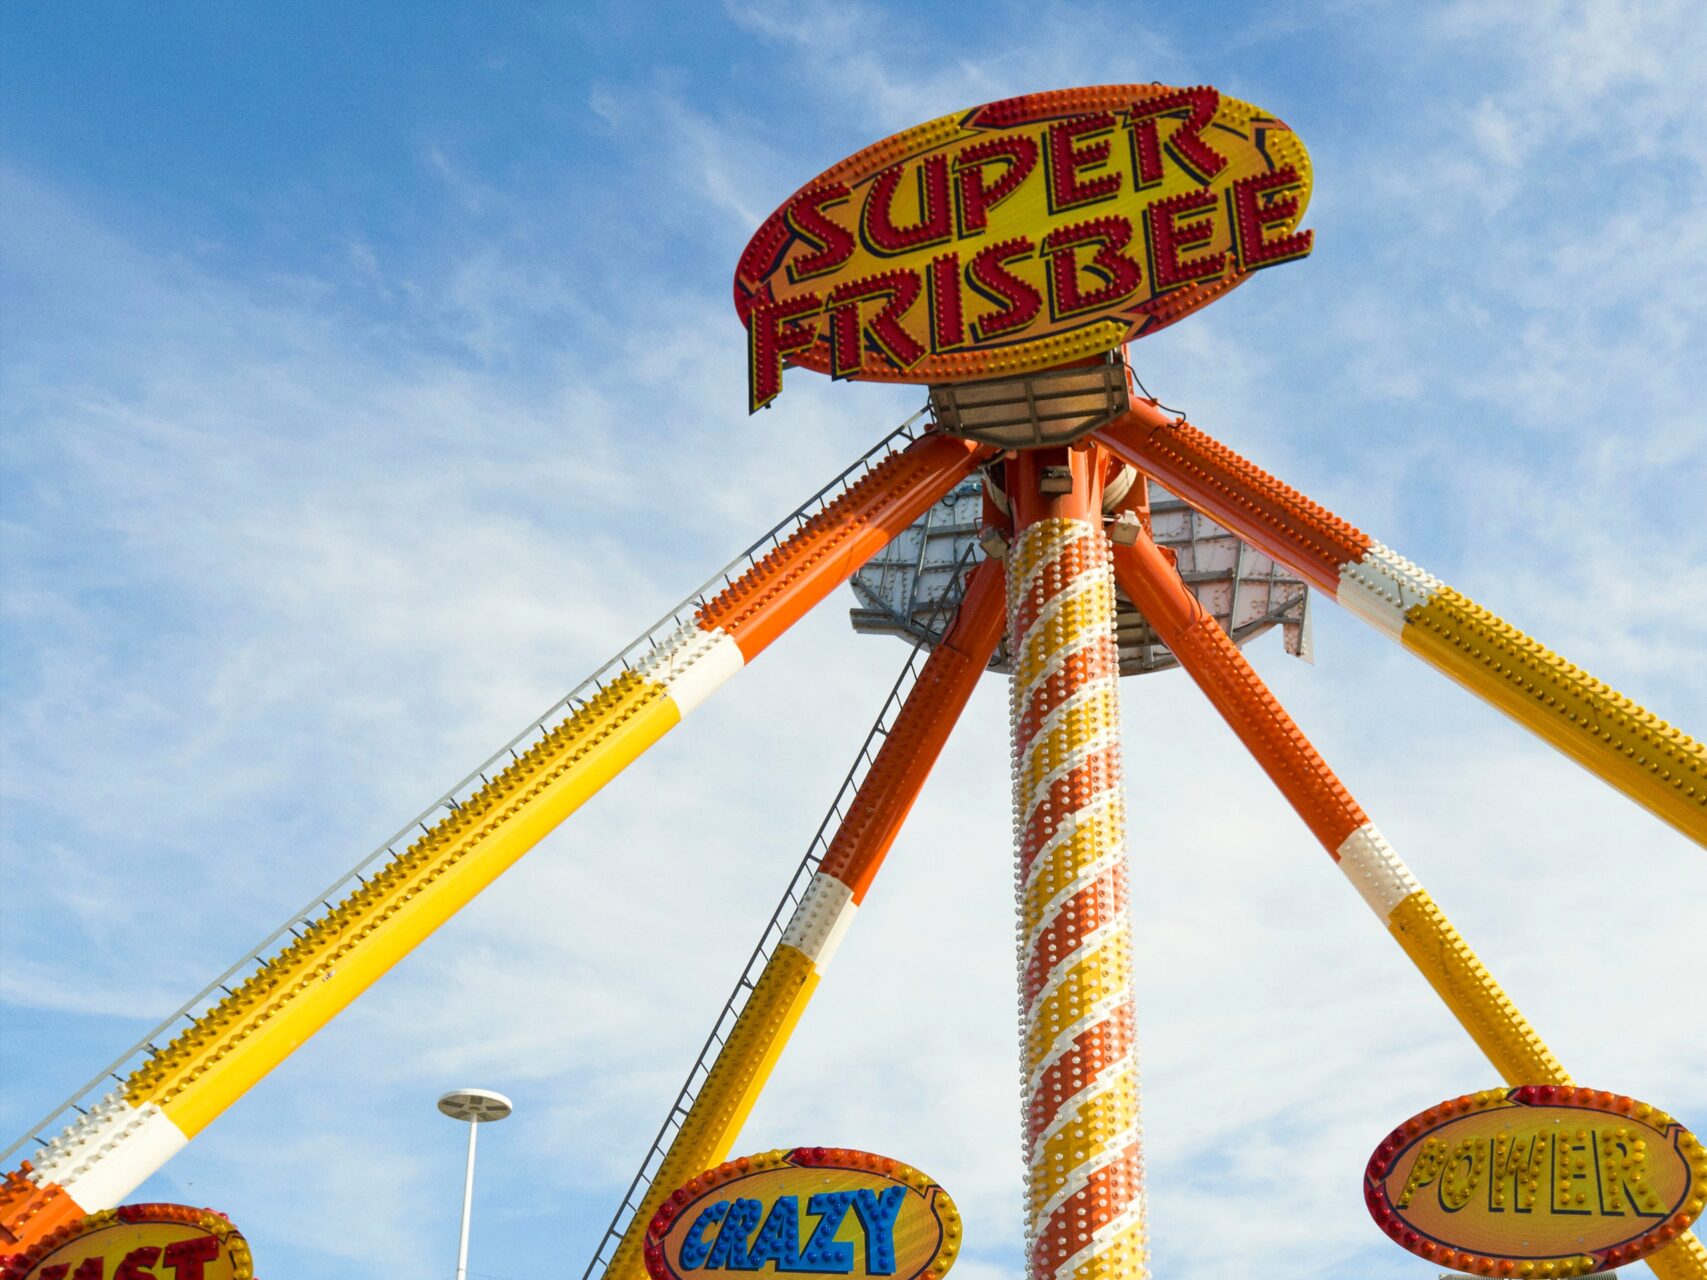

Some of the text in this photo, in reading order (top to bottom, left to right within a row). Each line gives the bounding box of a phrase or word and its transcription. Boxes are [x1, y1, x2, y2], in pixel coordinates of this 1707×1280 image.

[786, 85, 1229, 284] SUPER
[749, 164, 1314, 414] FRISBEE
[678, 1186, 907, 1276] CRAZY
[1396, 1127, 1669, 1217] POWER
